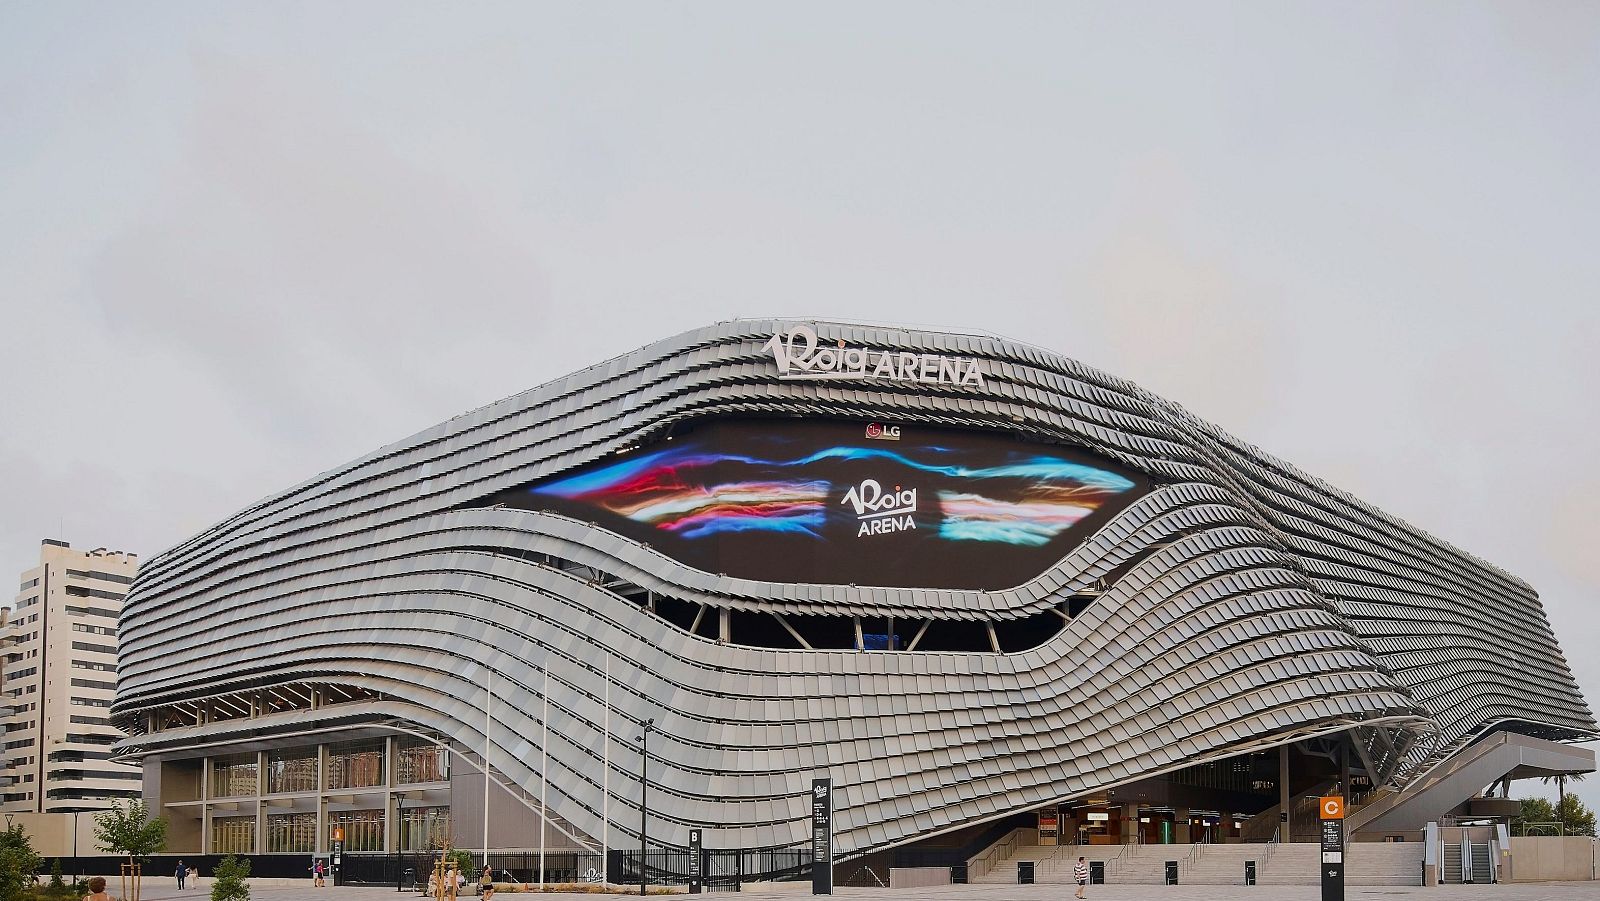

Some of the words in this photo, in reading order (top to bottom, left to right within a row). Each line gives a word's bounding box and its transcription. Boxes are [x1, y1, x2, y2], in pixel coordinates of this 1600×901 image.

[761, 326, 868, 380] Roig
[872, 350, 985, 387] ARENA
[841, 479, 917, 520] Roig
[857, 515, 917, 538] ARENA
[1324, 801, 1339, 815] C
[691, 831, 698, 842] B
